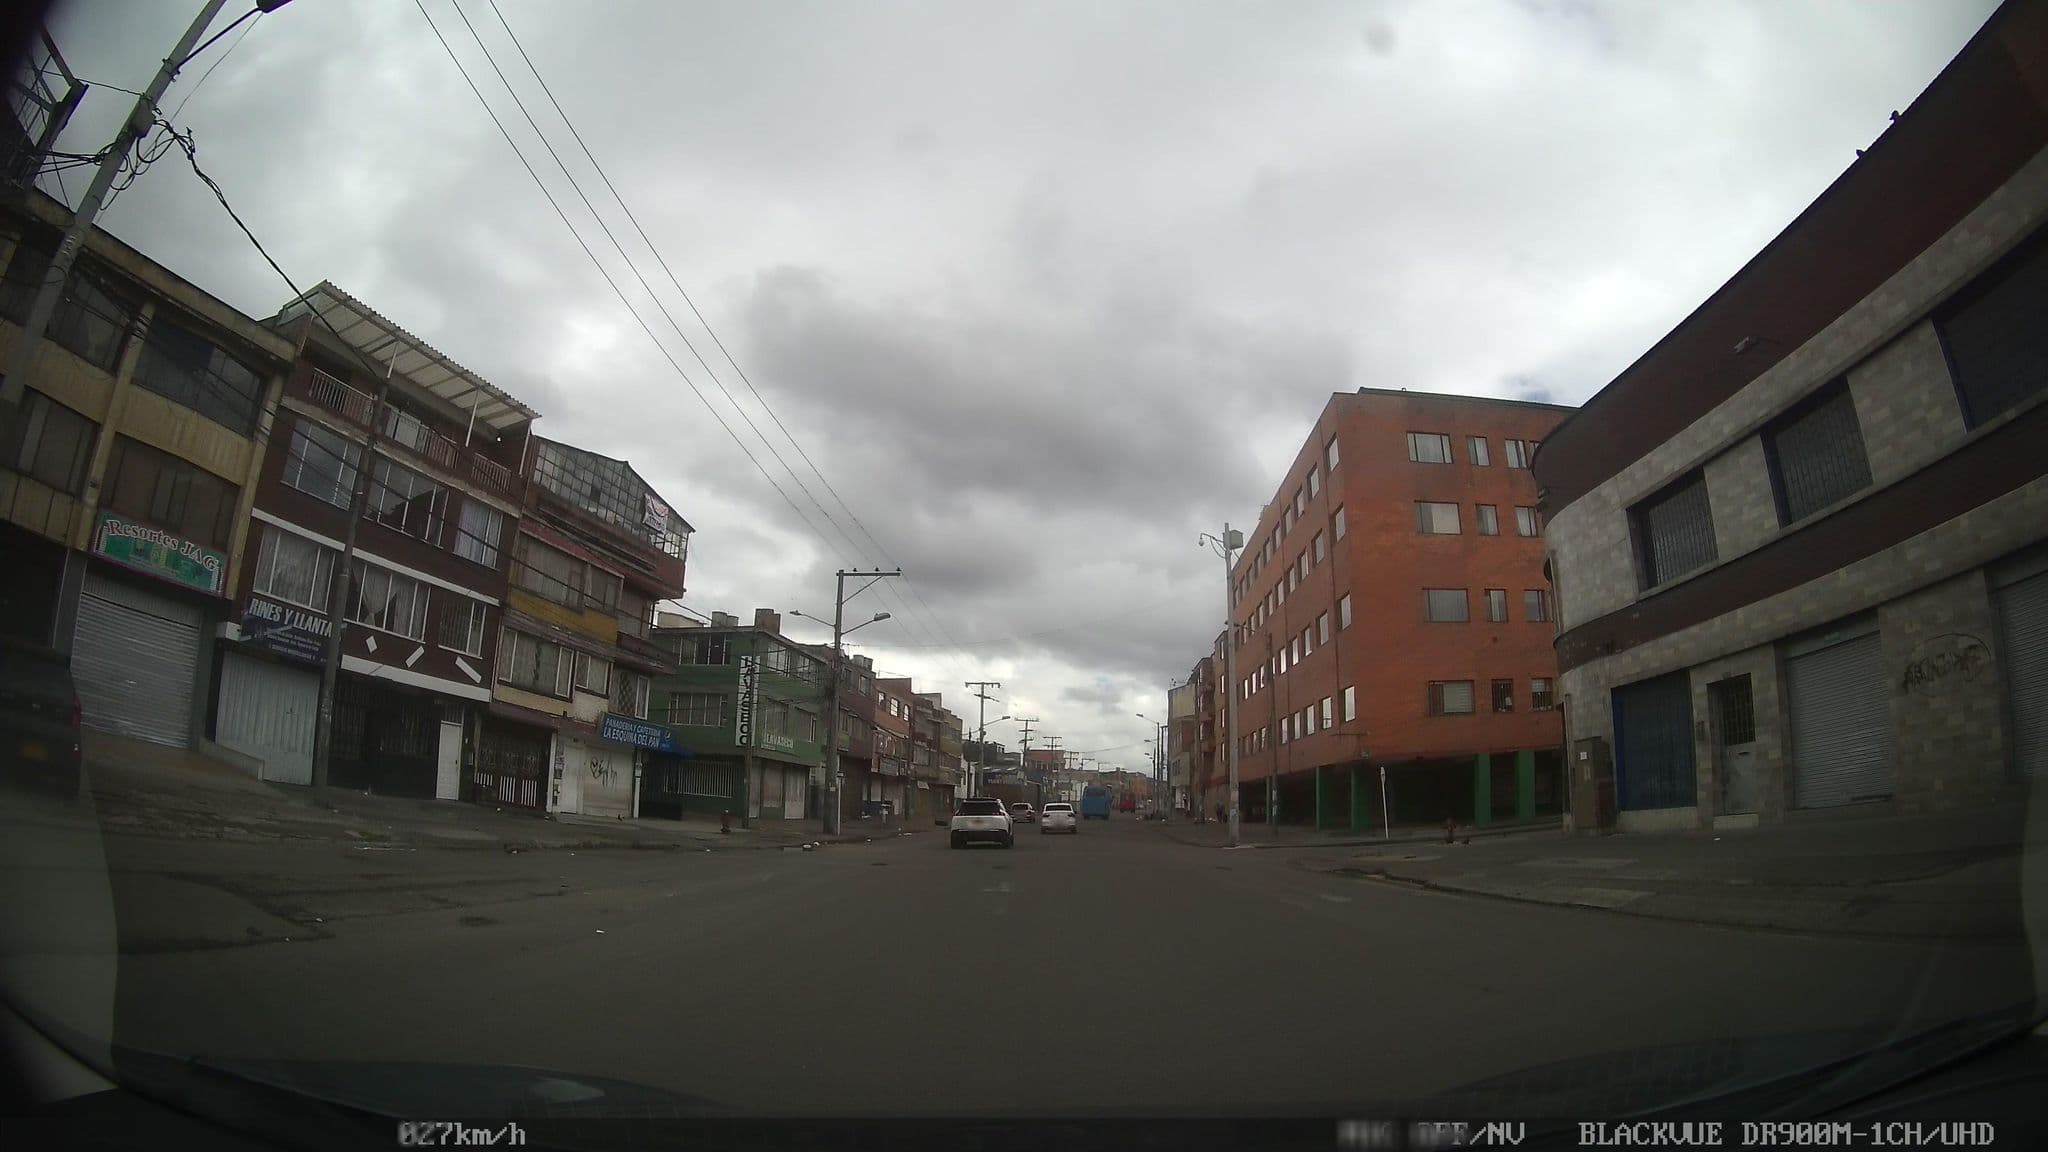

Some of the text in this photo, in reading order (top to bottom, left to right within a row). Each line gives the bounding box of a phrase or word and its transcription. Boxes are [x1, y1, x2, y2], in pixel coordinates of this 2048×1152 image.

[106, 519, 219, 572] Resortes JAG
[249, 598, 282, 622] RINES
[284, 608, 294, 625] Y
[293, 612, 334, 638] LLANTA
[603, 727, 612, 739] LA
[612, 729, 637, 744] ESQUINA
[637, 734, 648, 746] DEL
[648, 736, 660, 749] PAN
